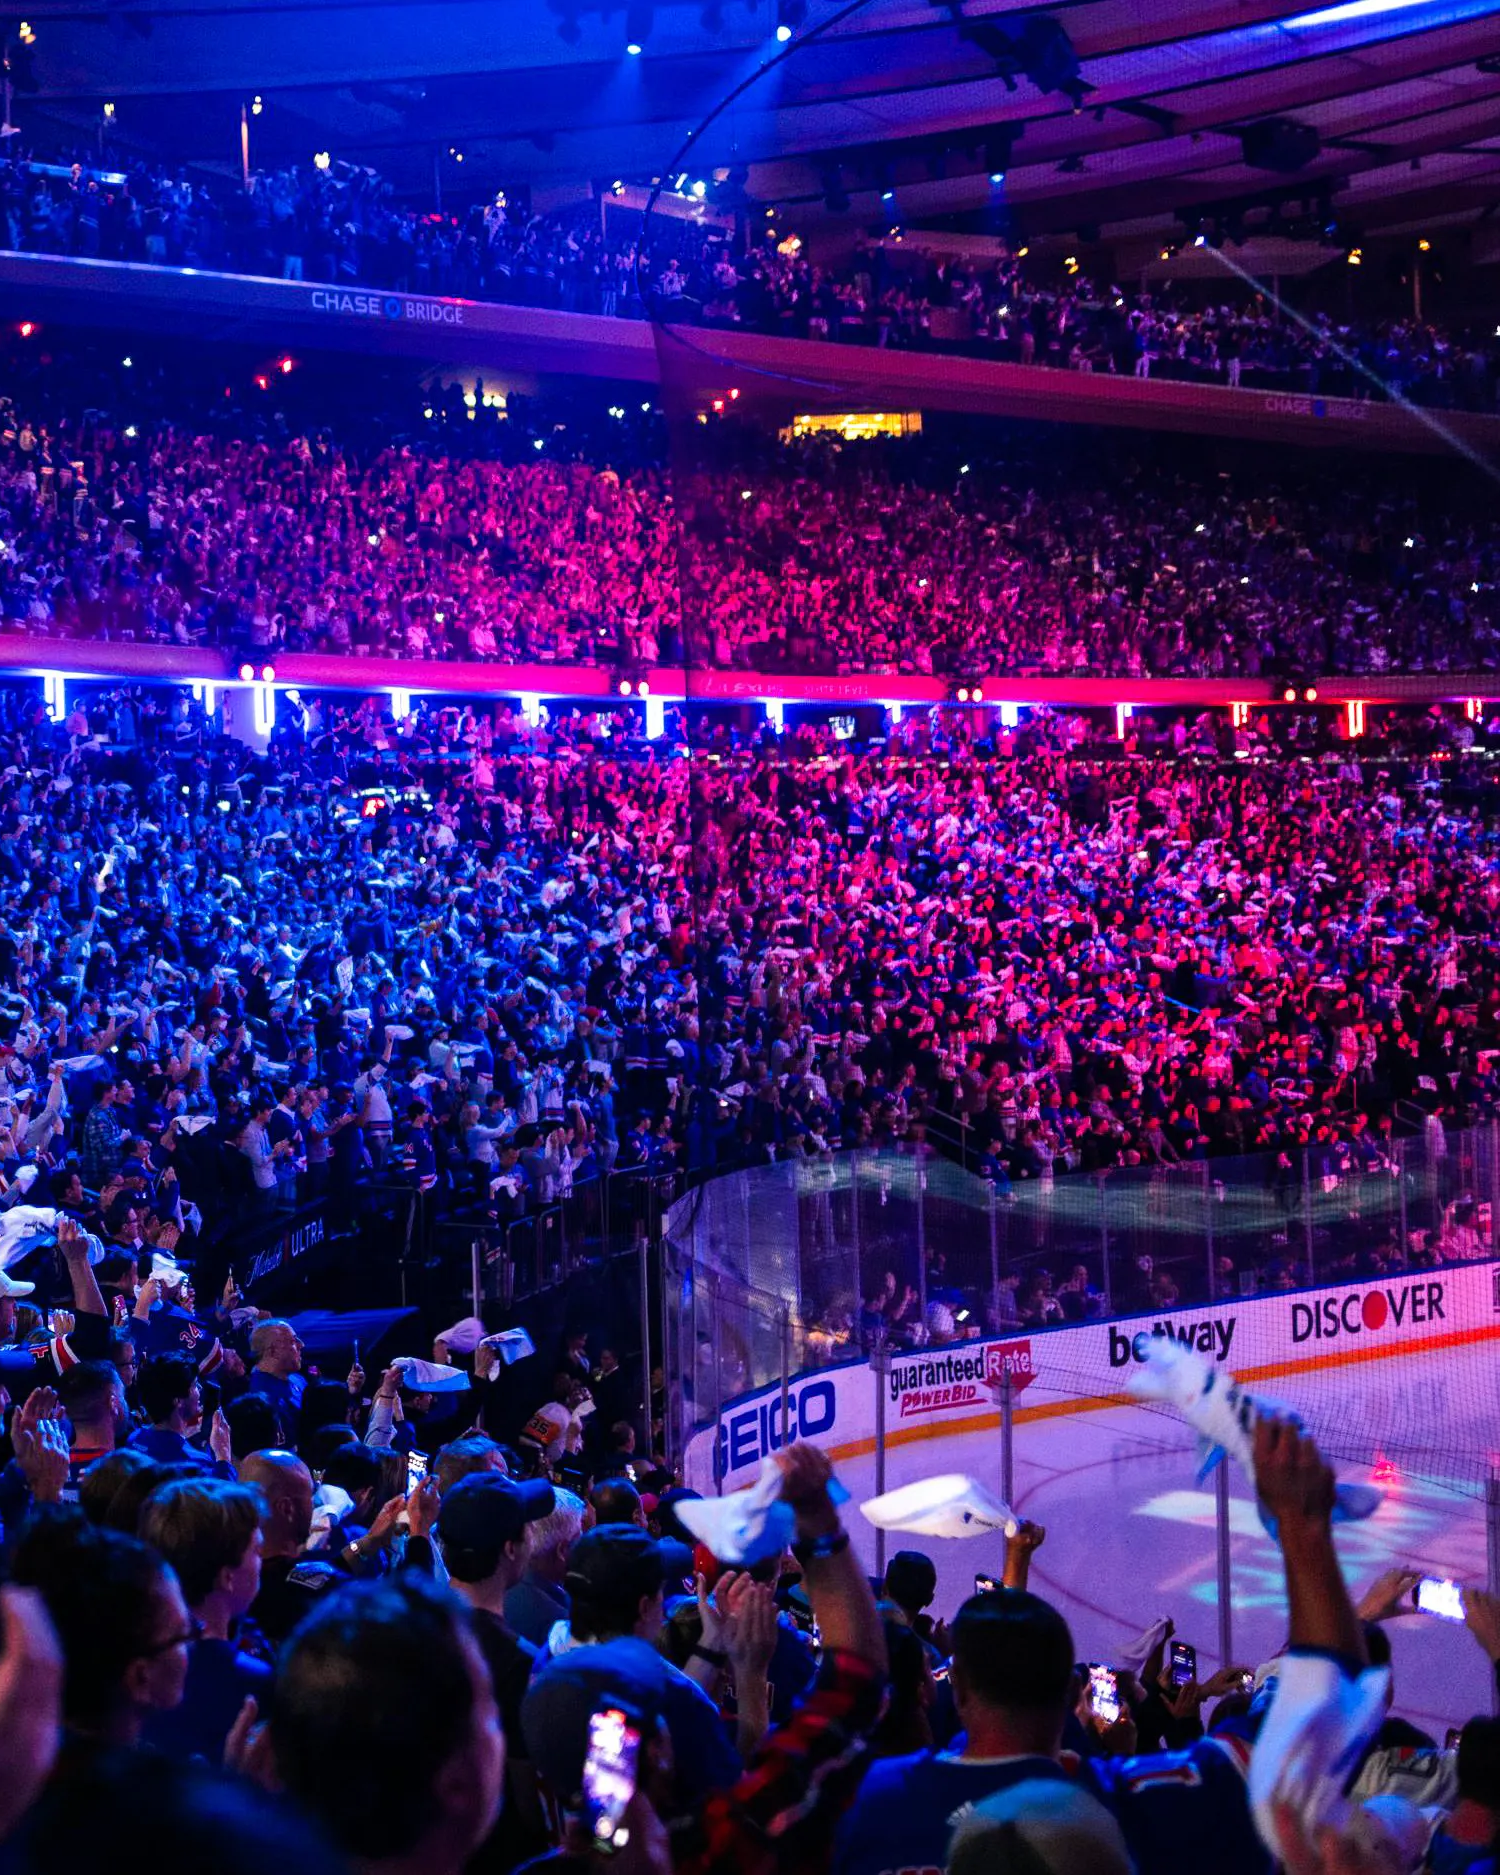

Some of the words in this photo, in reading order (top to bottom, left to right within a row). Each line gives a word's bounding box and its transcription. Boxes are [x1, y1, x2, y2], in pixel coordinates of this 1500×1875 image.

[311, 291, 381, 316] CHASE
[406, 301, 463, 324] BRIDGE
[1264, 398, 1313, 415] CHASE
[291, 1216, 325, 1257] ULTRA
[1292, 1282, 1445, 1343] DISCOVER
[891, 1346, 985, 1401] guaranteed
[713, 1380, 836, 1488] GEICO
